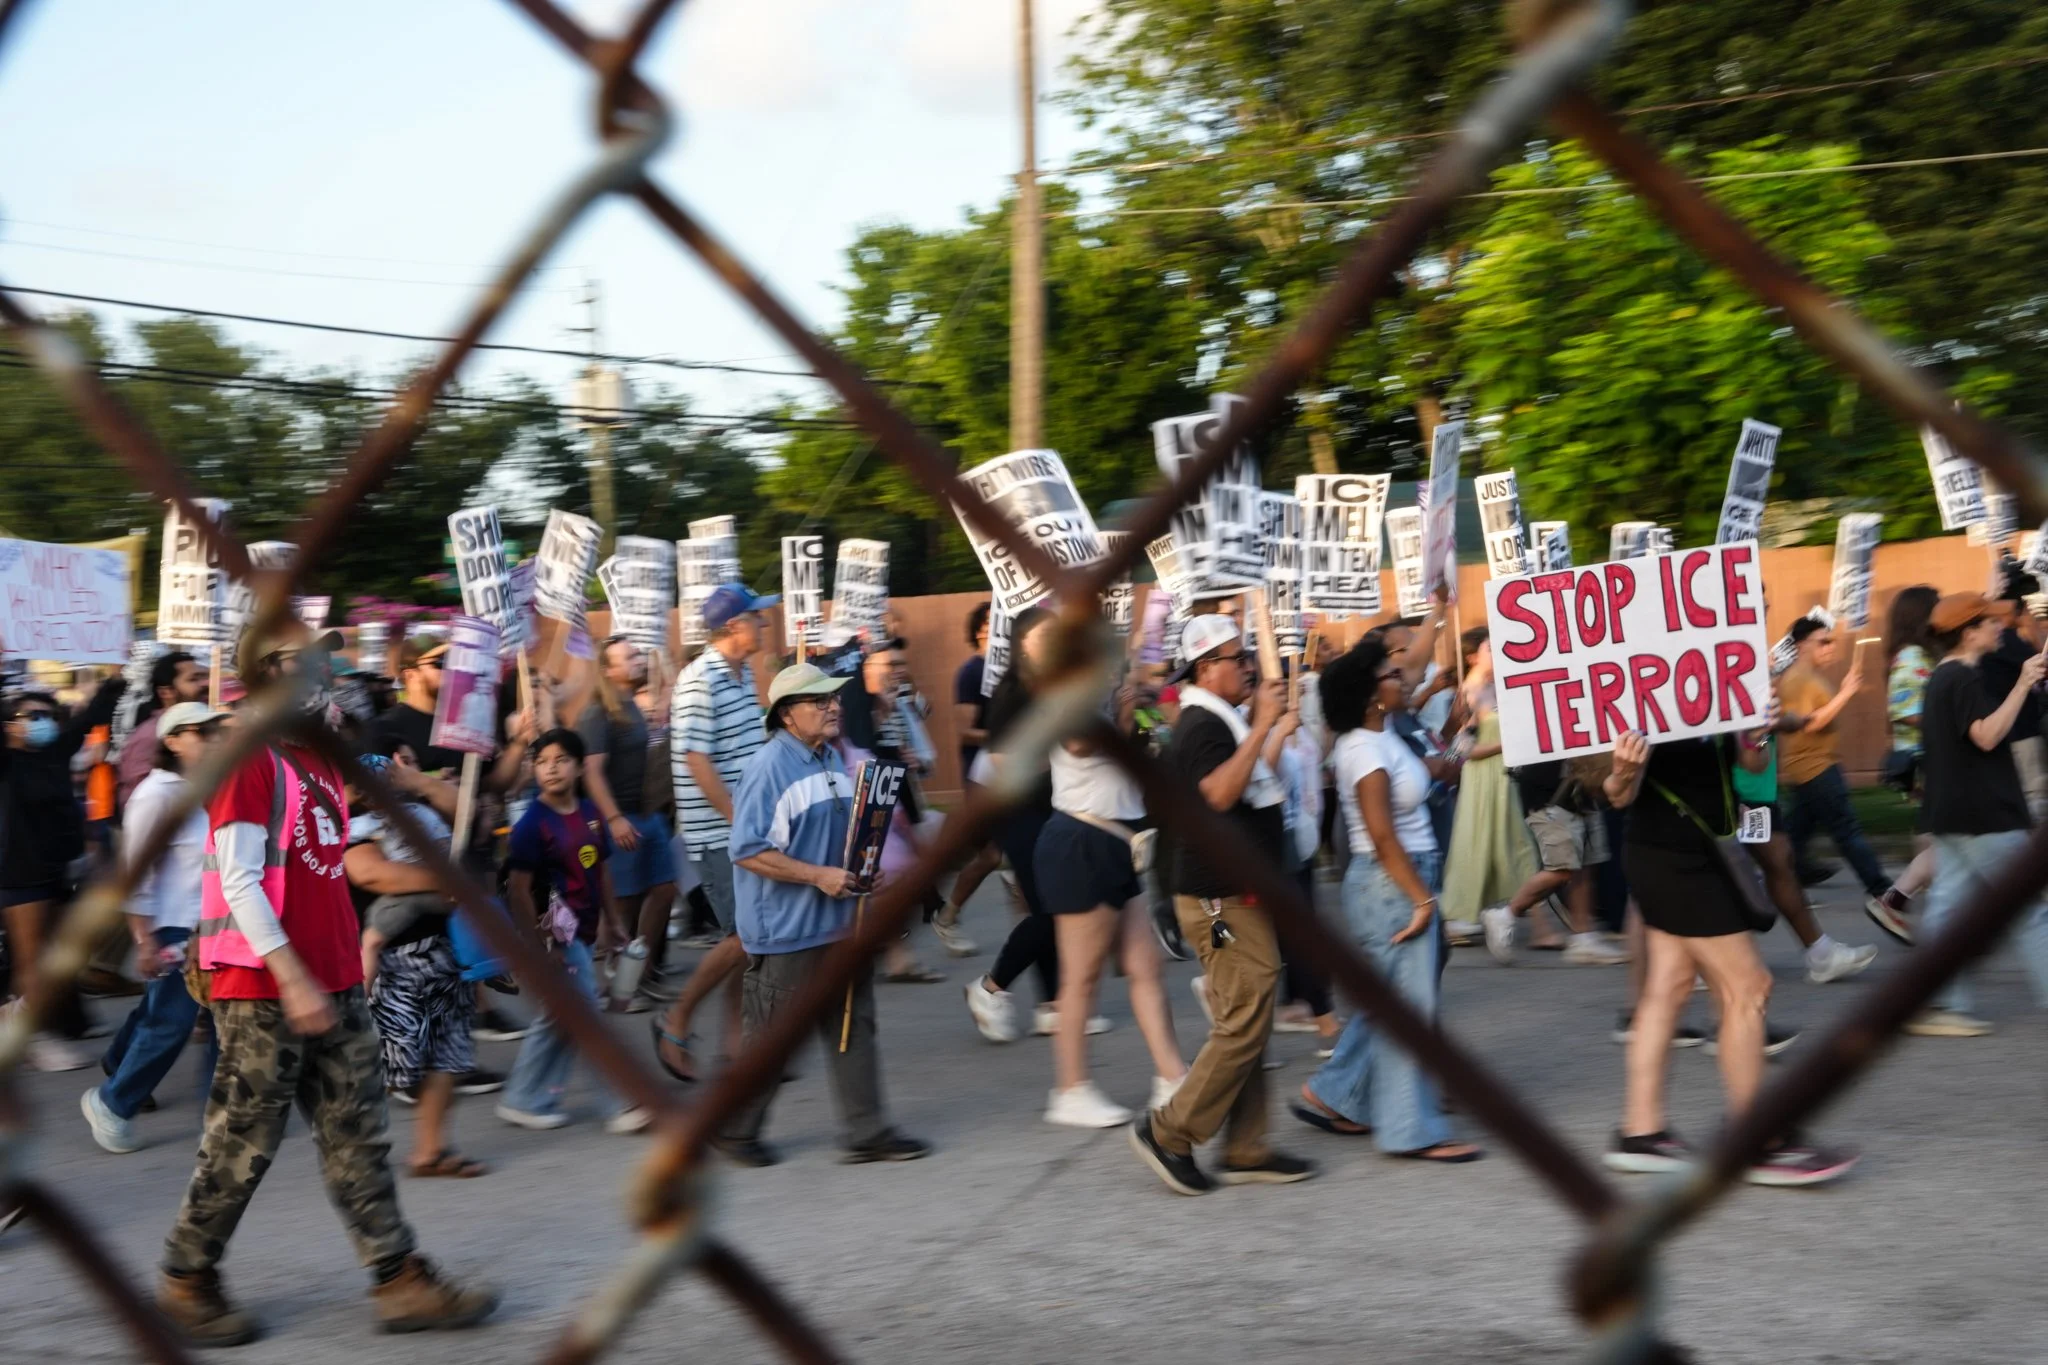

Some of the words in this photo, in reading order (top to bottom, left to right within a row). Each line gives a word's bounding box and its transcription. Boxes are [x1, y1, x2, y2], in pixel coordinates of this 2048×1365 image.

[994, 561, 1018, 591] OF
[1496, 563, 1636, 663] STOP
[1659, 547, 1758, 633] ICE
[1503, 640, 1756, 754] TERROR
[867, 765, 905, 806] ICE
[301, 849, 329, 876] FOR
